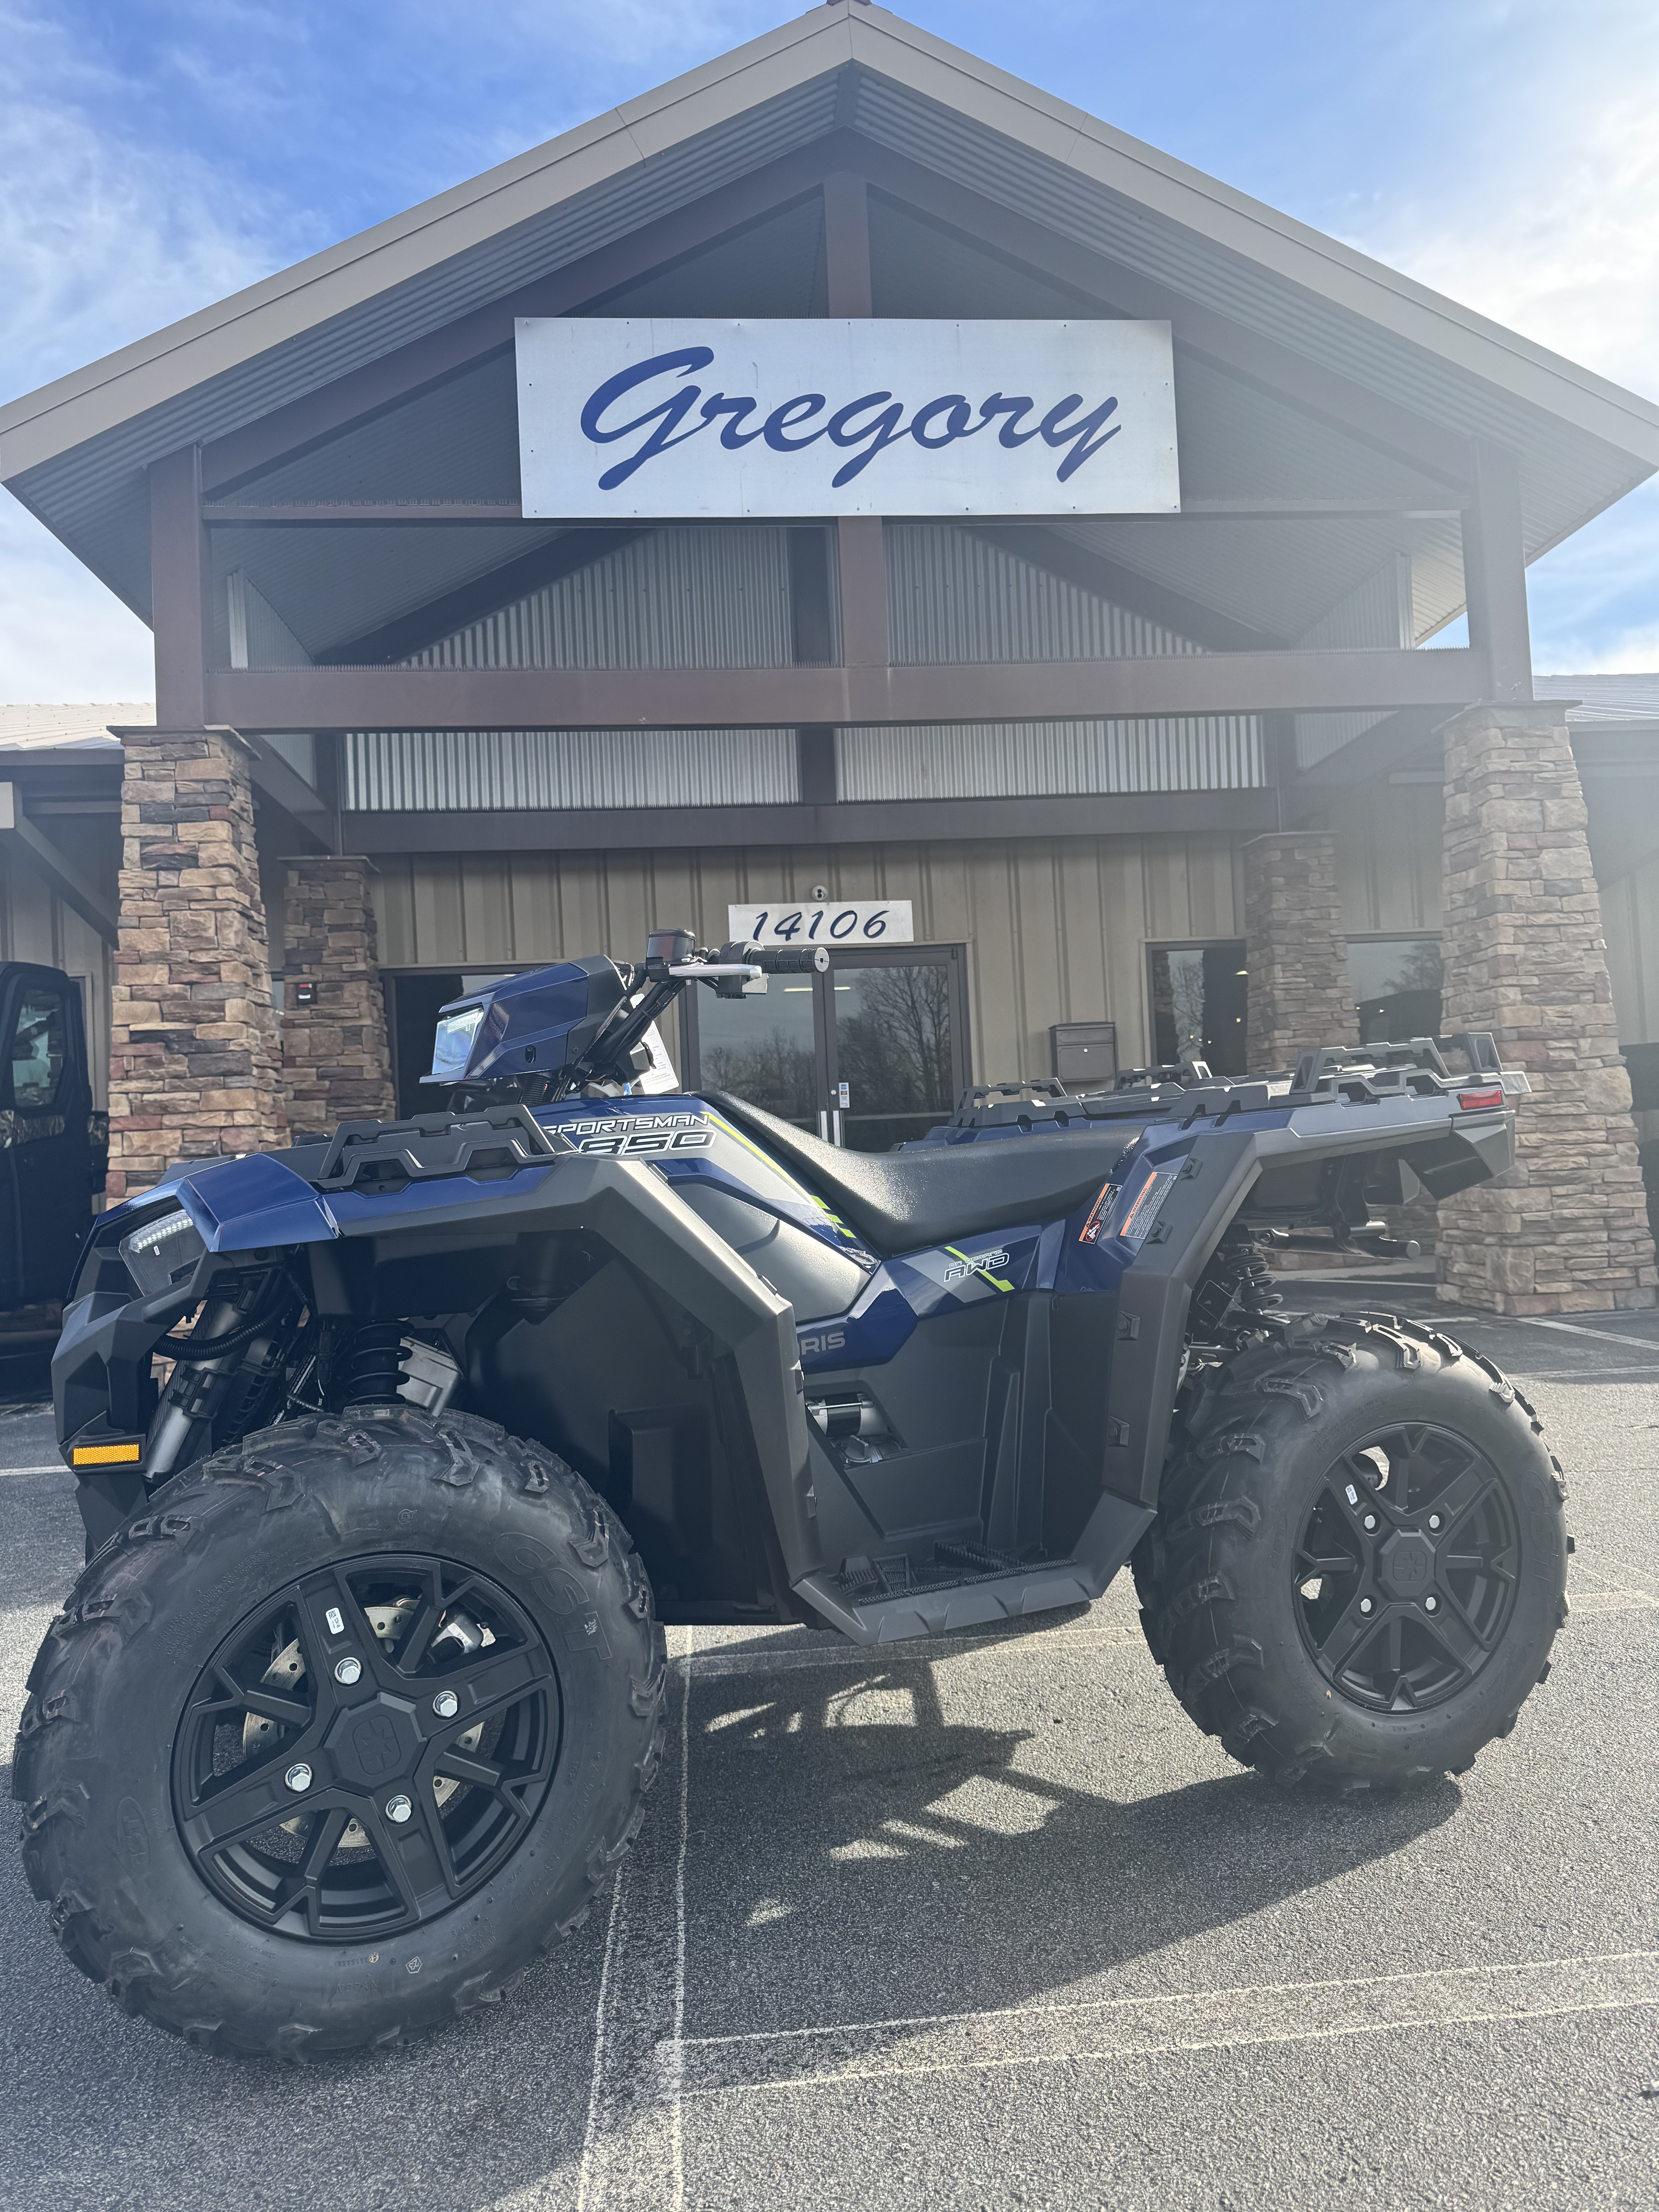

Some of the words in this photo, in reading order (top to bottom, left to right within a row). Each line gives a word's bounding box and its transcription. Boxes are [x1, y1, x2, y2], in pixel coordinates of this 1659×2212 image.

[581, 346, 1121, 491] Gregory
[753, 910, 890, 941] 14106
[543, 1115, 709, 1135] SPORTSMAN
[579, 1129, 717, 1156] 850
[1088, 1197, 1102, 1223] WARNING
[1132, 1188, 1147, 1214] WARNING
[944, 1253, 1010, 1282] AWD
[800, 1331, 846, 1355] RIS
[1521, 1470, 1558, 1598] CST
[495, 1532, 613, 1660] CST
[409, 1958, 421, 1970] 23
